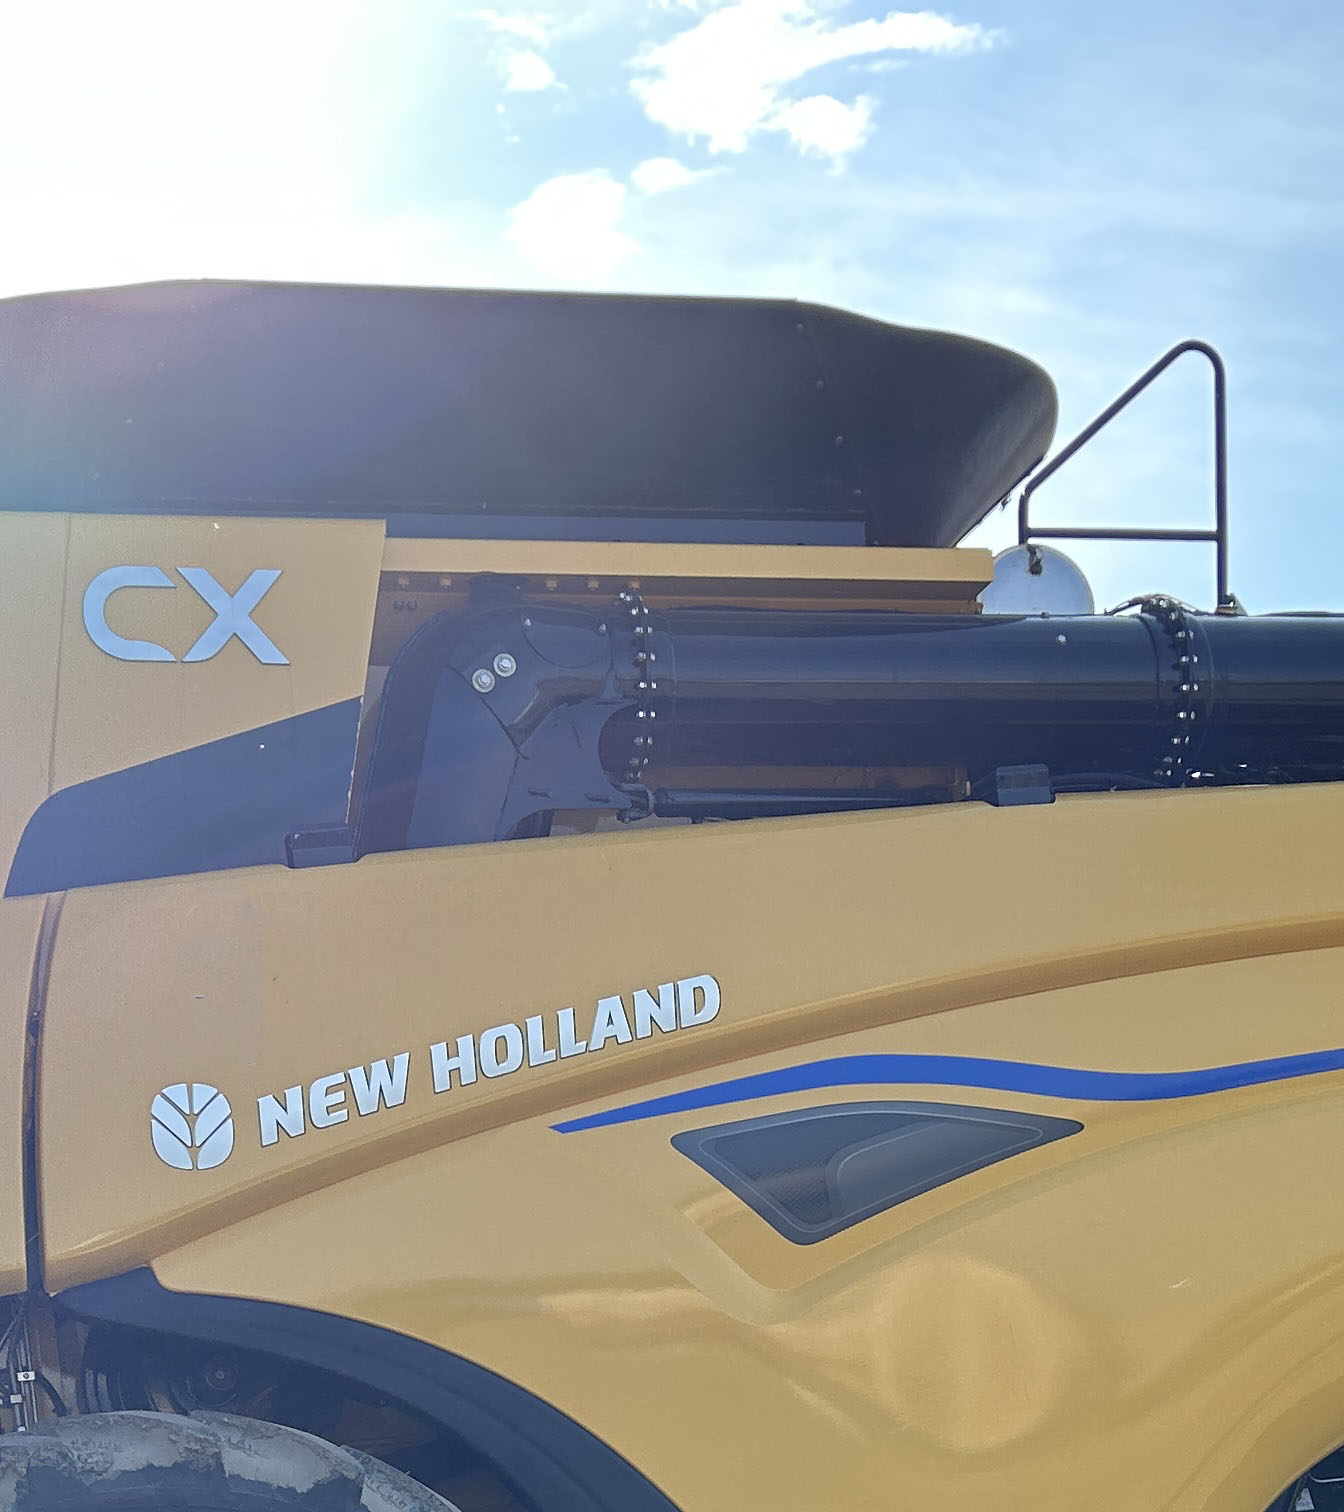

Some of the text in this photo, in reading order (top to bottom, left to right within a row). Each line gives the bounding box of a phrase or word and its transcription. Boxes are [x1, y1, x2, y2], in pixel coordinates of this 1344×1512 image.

[82, 565, 291, 666] CX
[257, 973, 723, 1148] NEW HOLLAND
